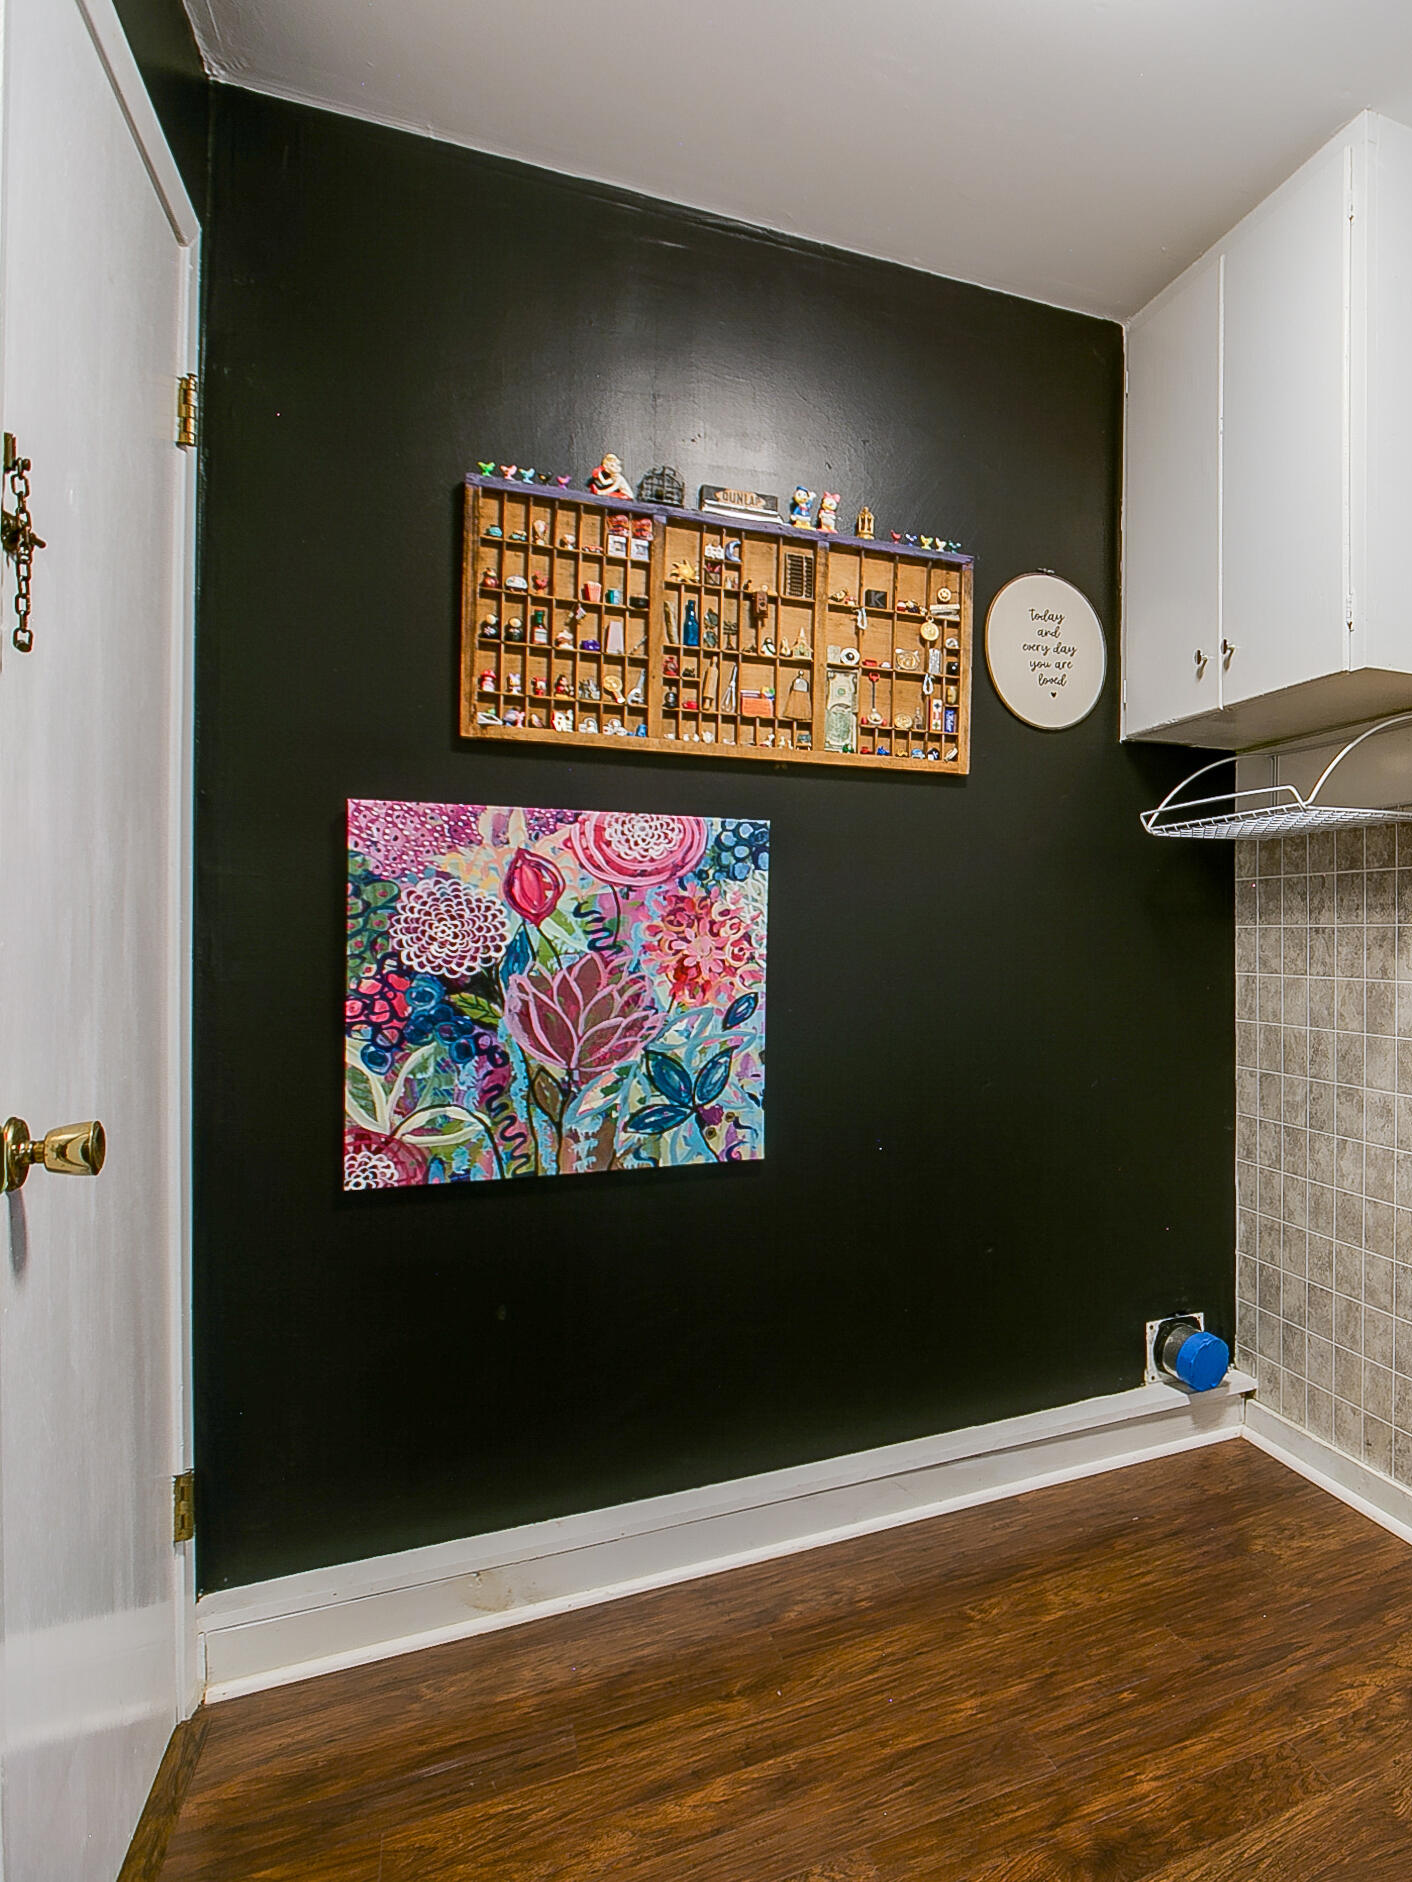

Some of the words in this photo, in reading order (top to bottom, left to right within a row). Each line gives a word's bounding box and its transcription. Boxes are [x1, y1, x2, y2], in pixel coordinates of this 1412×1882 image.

[870, 590, 886, 608] K
[1037, 625, 1061, 639] and
[1022, 642, 1051, 656] every
[1052, 642, 1078, 657] day
[1029, 660, 1052, 672] you
[1054, 659, 1073, 670] are
[1038, 673, 1067, 687] loved
